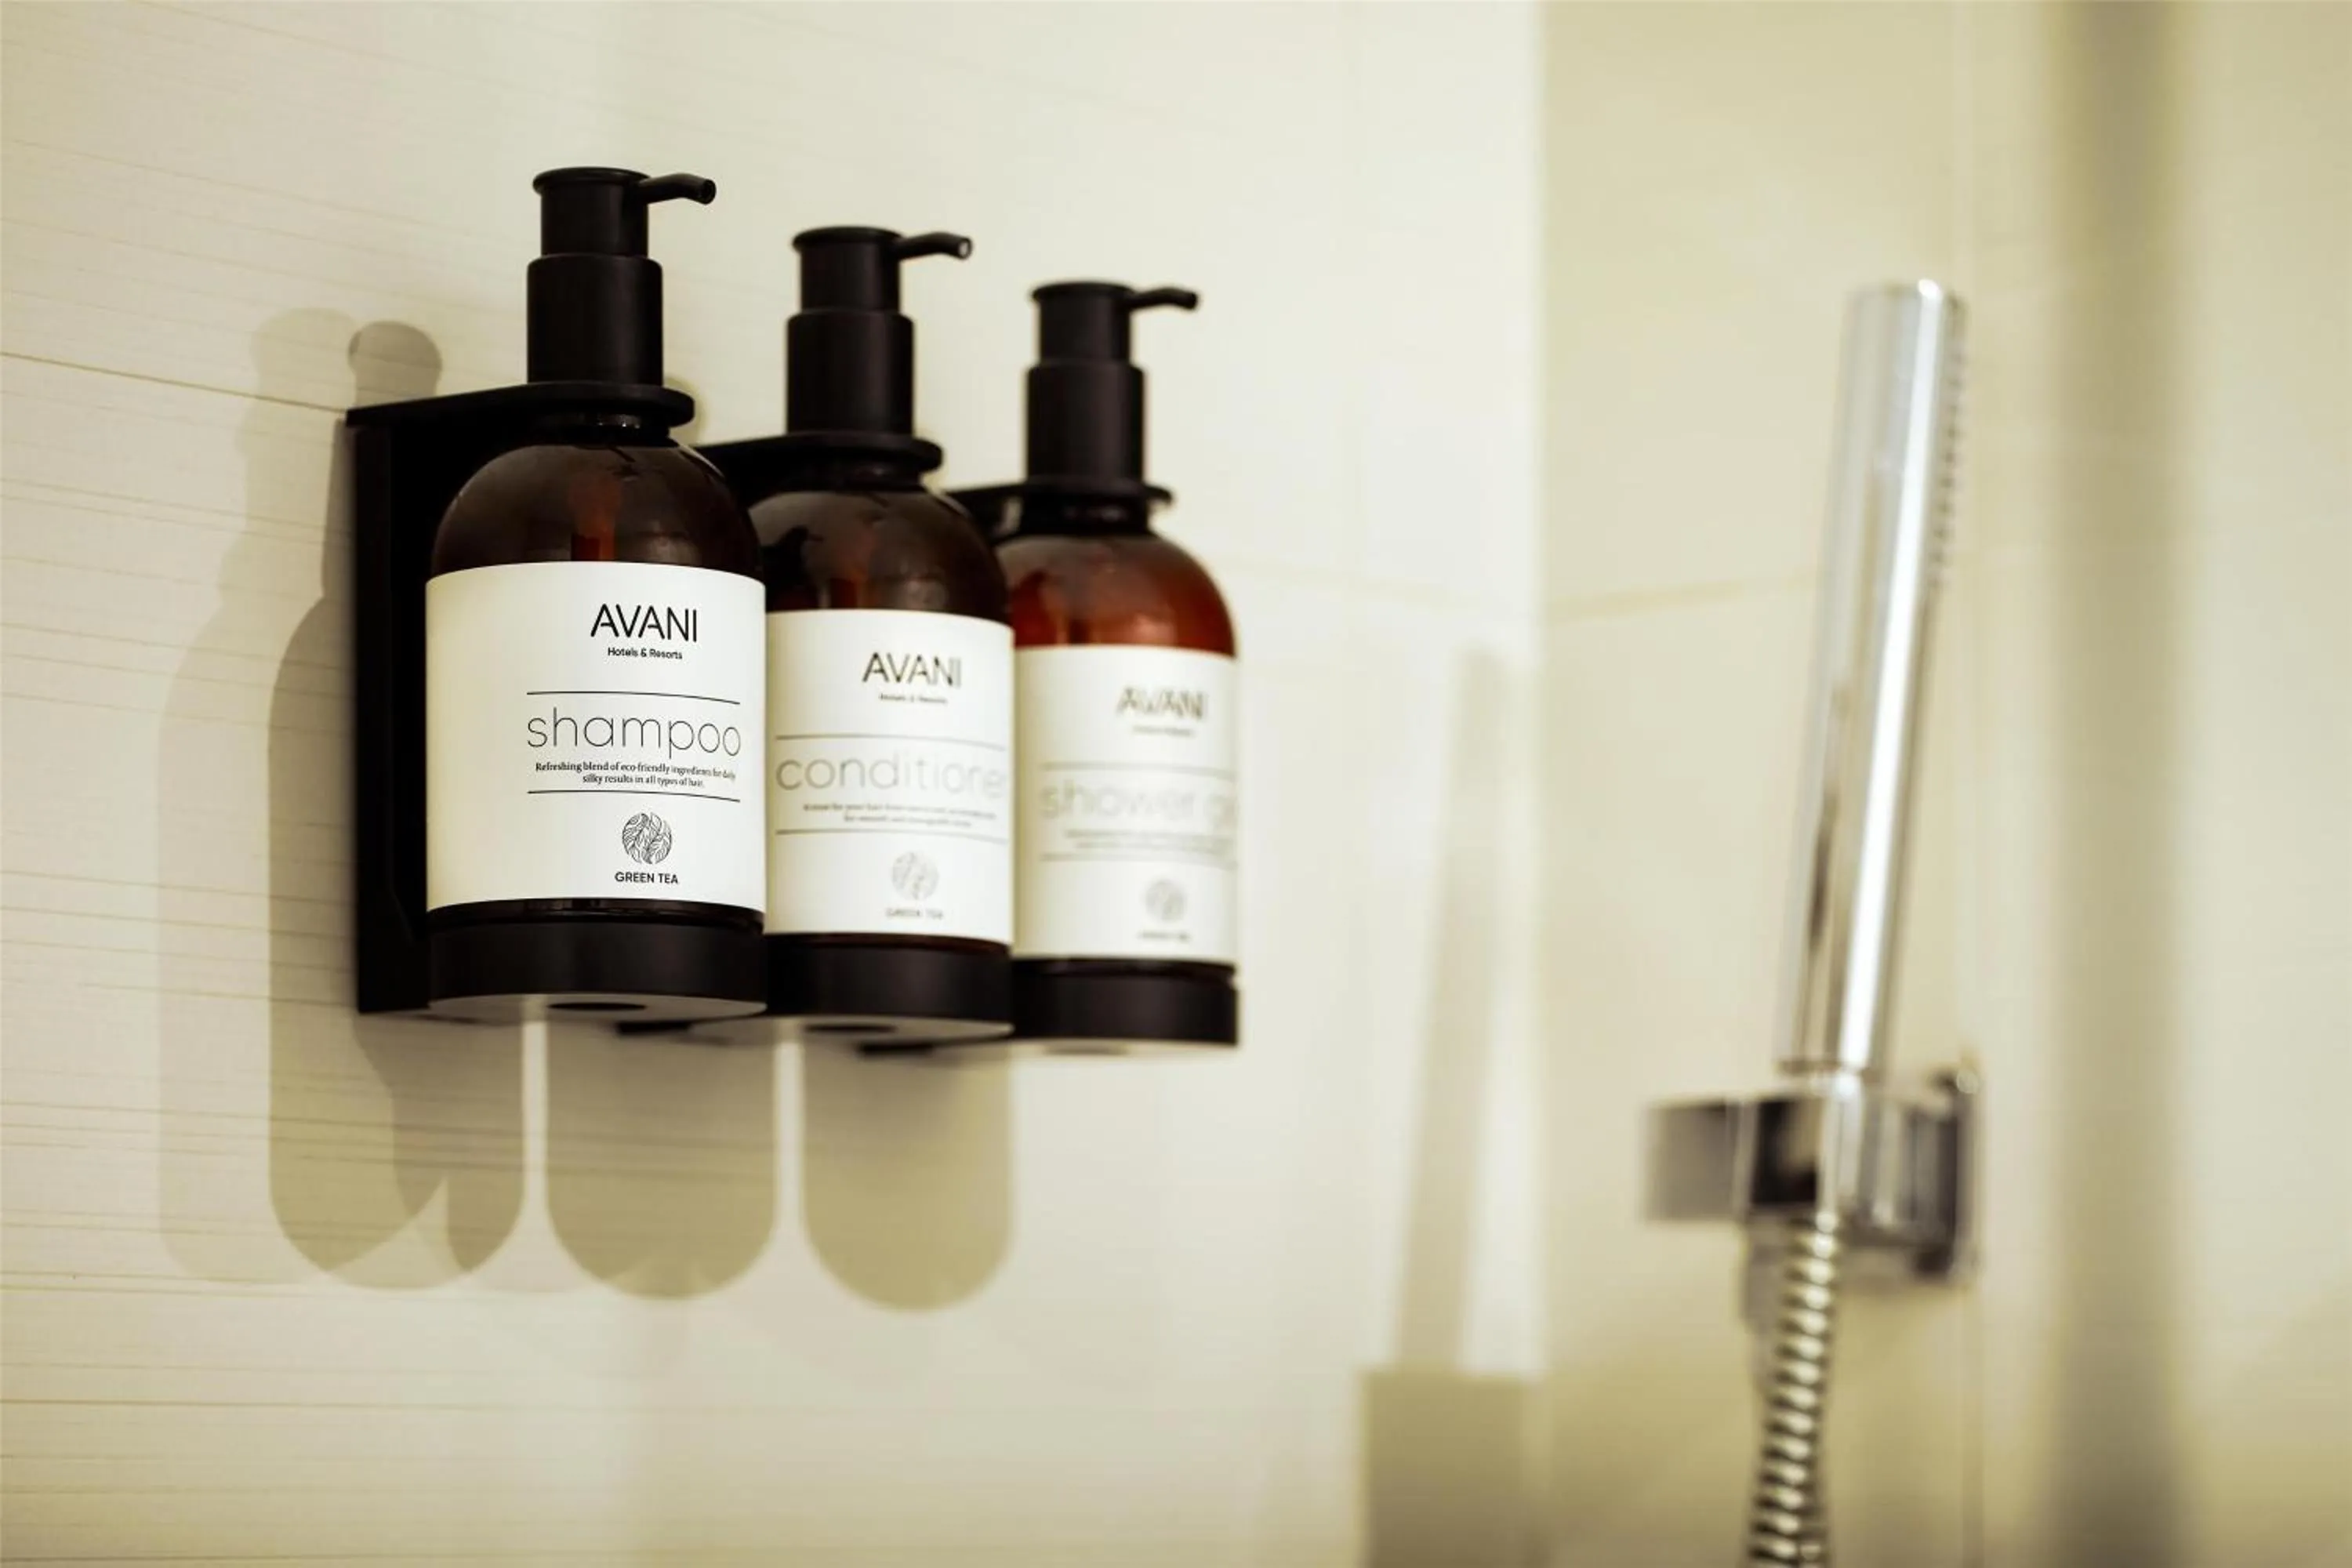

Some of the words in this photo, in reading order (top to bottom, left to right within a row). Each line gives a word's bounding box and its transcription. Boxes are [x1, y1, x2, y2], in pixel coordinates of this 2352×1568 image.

[590, 603, 698, 642] AVANI
[608, 647, 638, 657] Hotels
[641, 648, 648, 658] &
[649, 648, 683, 659] Resorts
[862, 652, 962, 689] AVANI
[527, 706, 741, 760] shampoo
[535, 761, 582, 773] Refreshing
[583, 762, 609, 771] blend
[610, 762, 620, 771] of
[620, 762, 670, 775] eco-friendly
[583, 774, 603, 785] silky
[604, 775, 633, 783] results
[645, 775, 656, 783] all
[657, 776, 678, 787] types
[678, 777, 688, 786] of
[615, 872, 655, 884] GREEN
[657, 873, 679, 884] TEA
